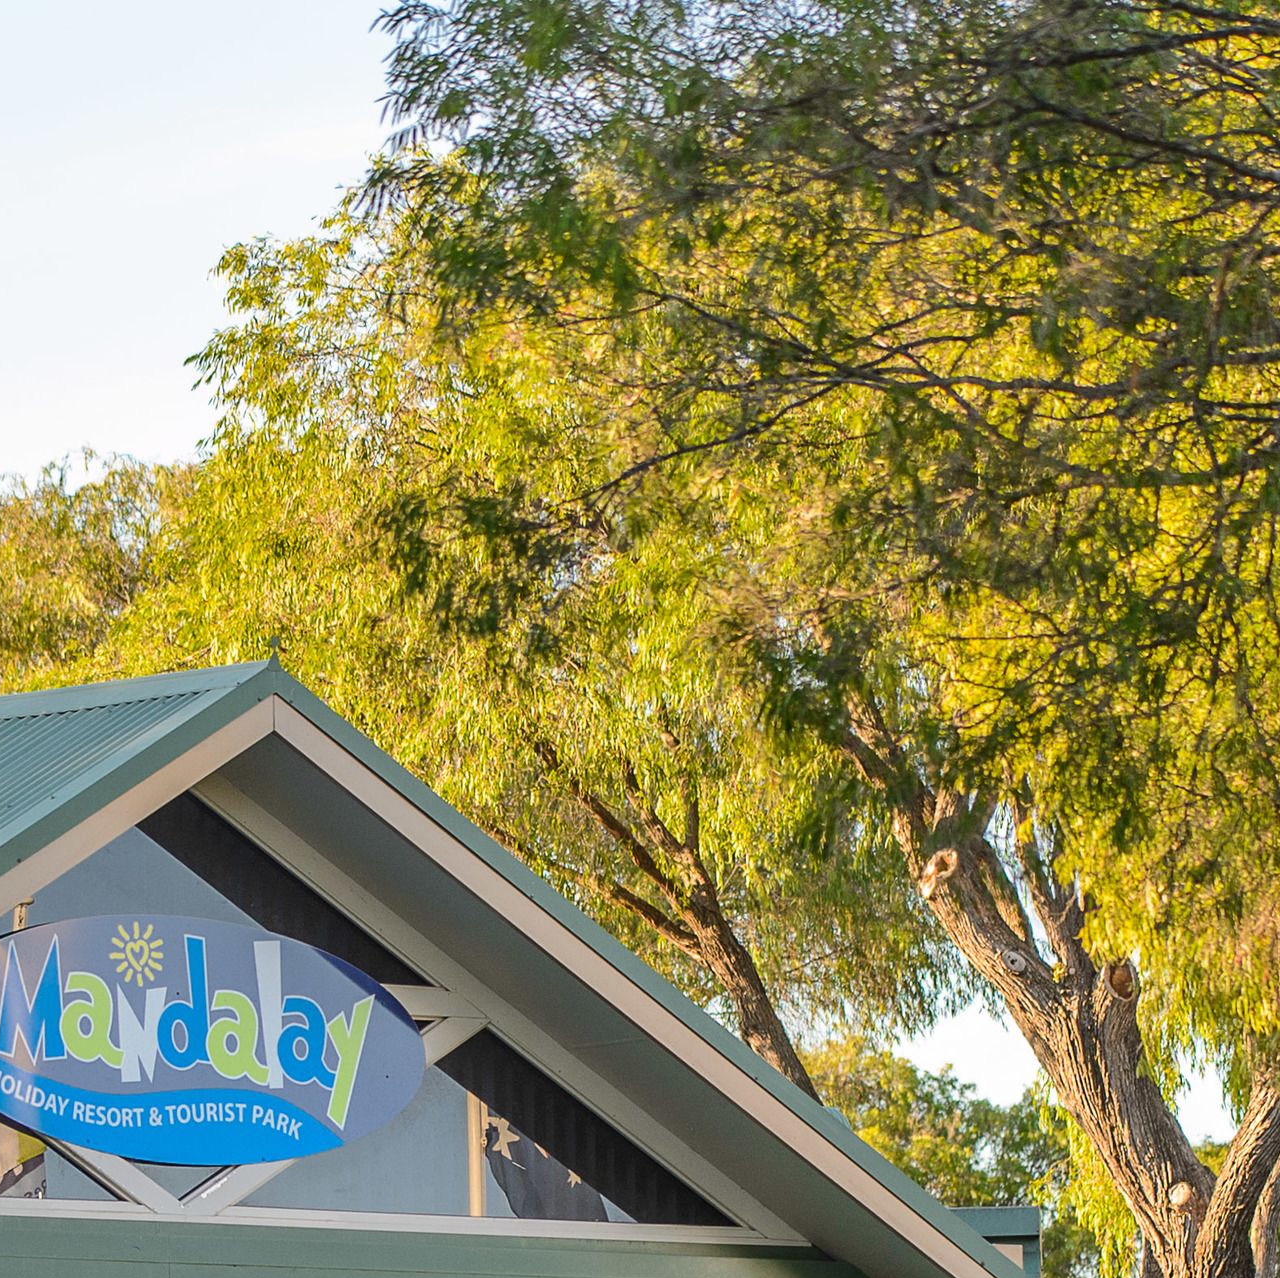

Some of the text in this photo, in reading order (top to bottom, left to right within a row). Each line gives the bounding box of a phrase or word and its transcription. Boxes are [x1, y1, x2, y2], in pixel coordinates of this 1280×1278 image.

[72, 1101, 144, 1128] RESORT
[148, 1106, 163, 1127] &
[165, 1102, 247, 1124] TOURIST
[251, 1104, 304, 1141] PARK
